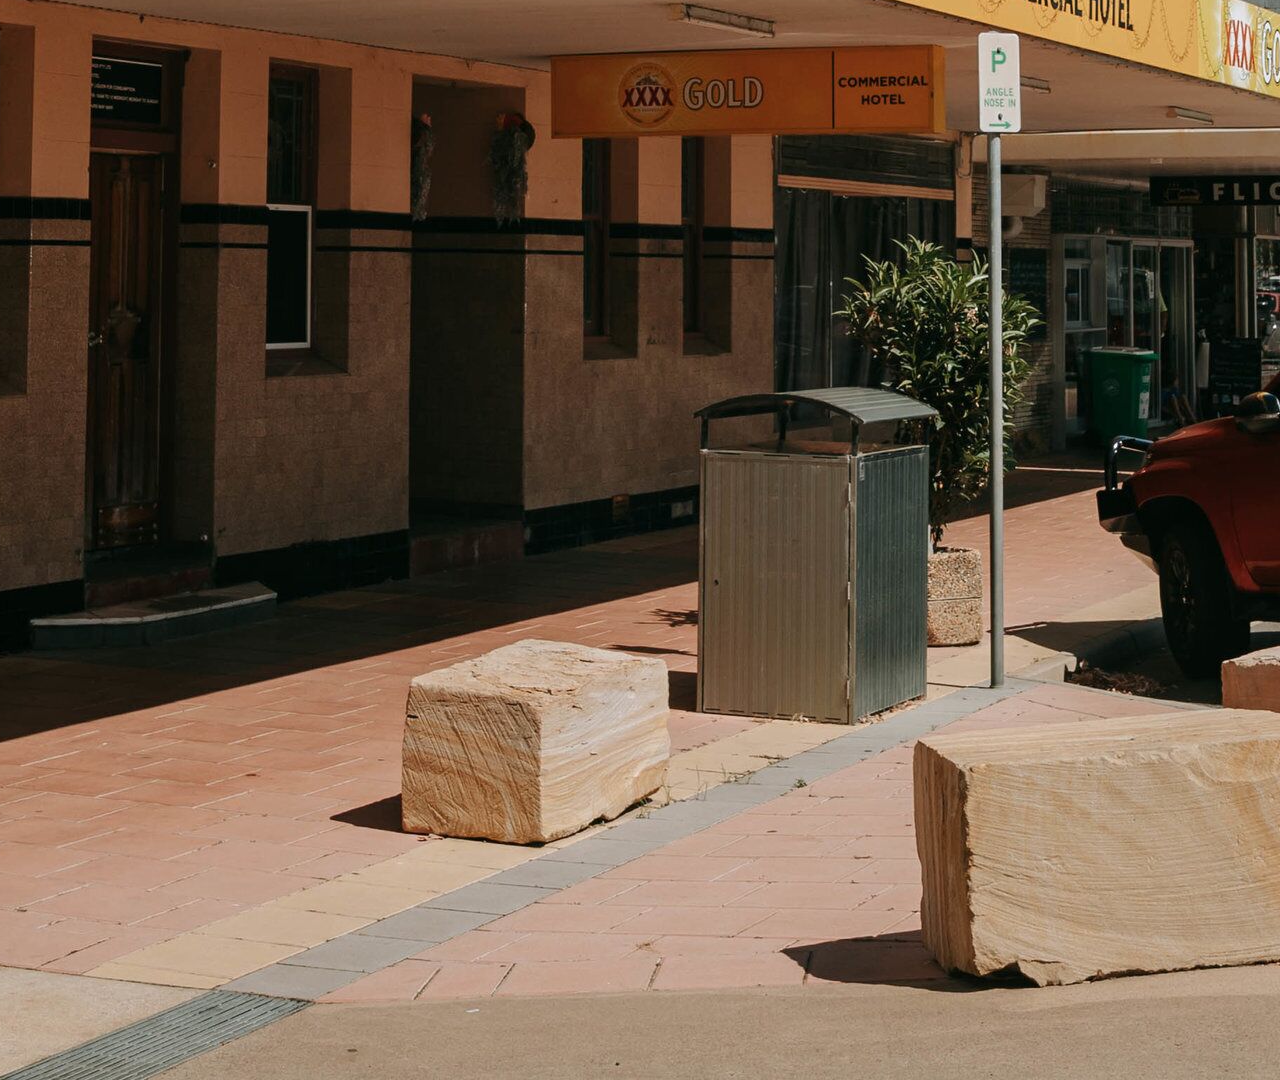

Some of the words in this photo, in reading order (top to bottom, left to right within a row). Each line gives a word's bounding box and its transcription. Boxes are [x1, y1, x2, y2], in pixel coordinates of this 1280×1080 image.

[1223, 20, 1257, 73] XXXX
[838, 75, 929, 89] COMMERCIAL
[622, 86, 673, 107] XXXX
[683, 76, 764, 111] GOLD
[986, 87, 1013, 97] ANGLE
[861, 93, 906, 106] HOTEL
[984, 98, 1005, 108] NOSE
[1008, 98, 1016, 108] IN
